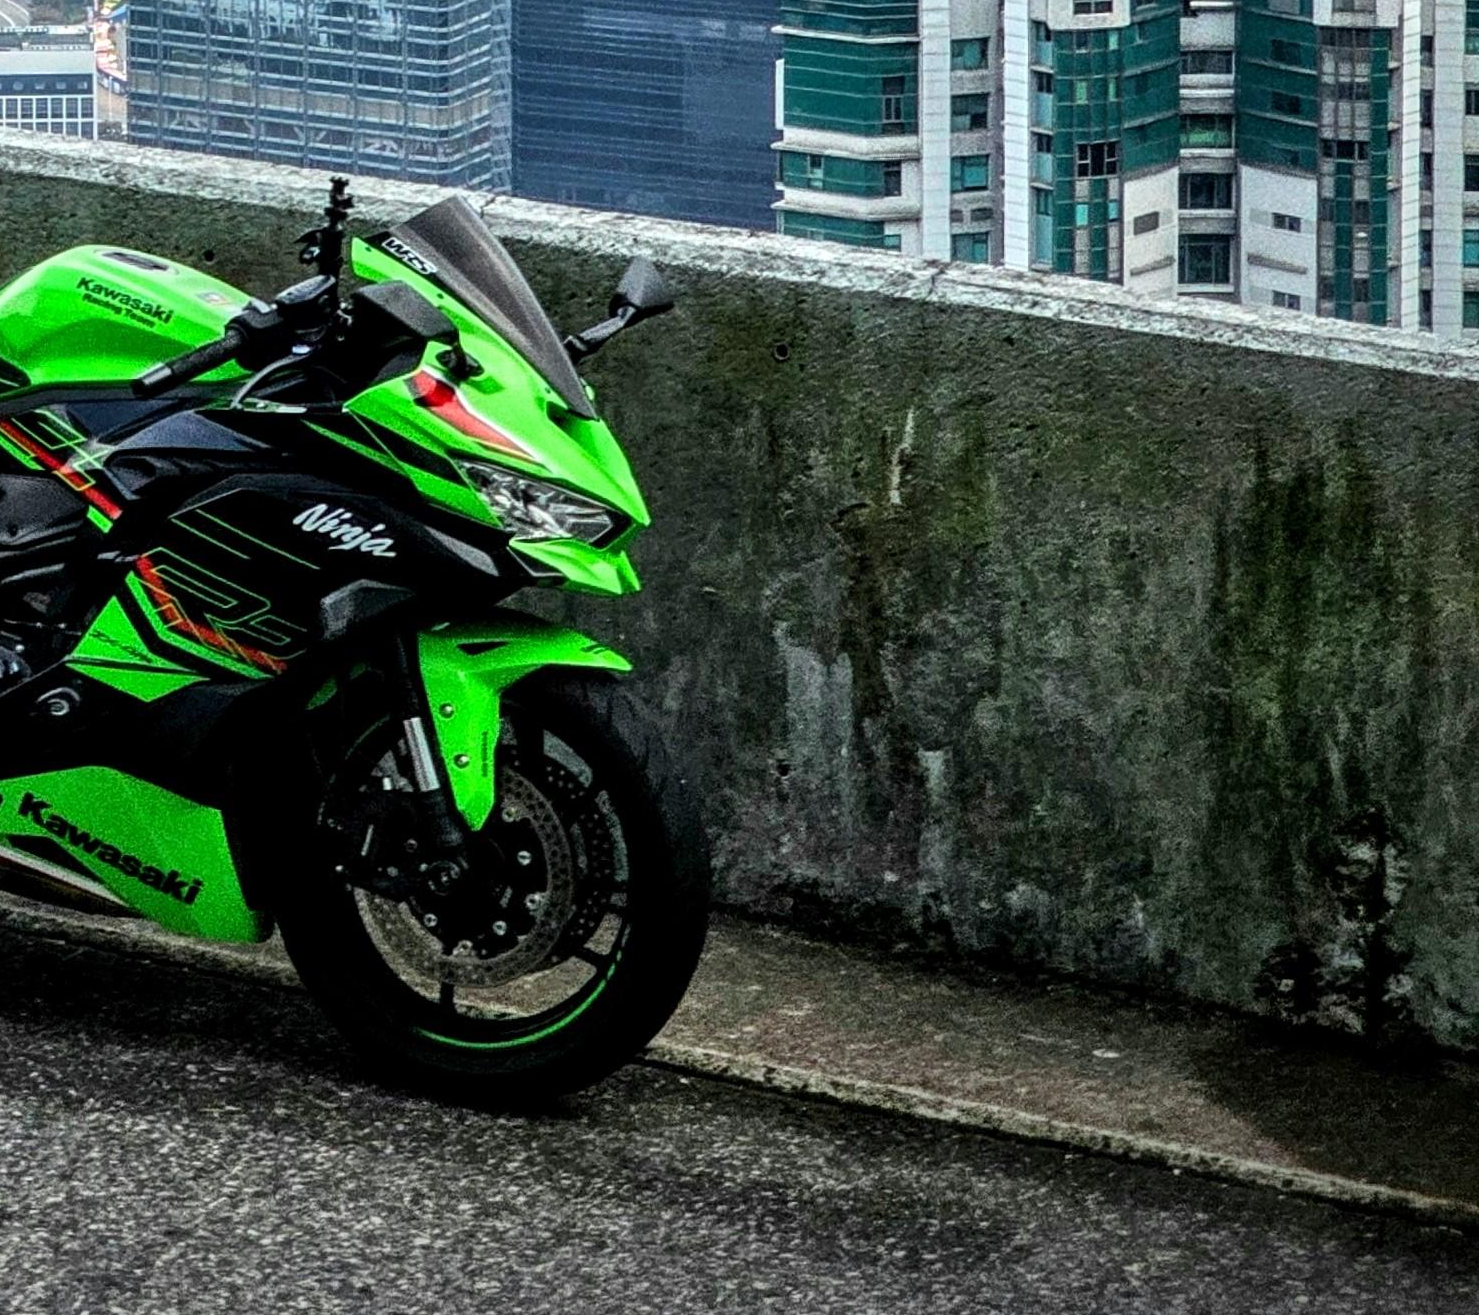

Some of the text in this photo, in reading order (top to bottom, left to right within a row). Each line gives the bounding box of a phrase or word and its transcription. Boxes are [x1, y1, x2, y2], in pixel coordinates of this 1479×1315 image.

[76, 277, 174, 324] Kawasaki
[82, 292, 156, 328] Racing Team
[292, 503, 397, 557] Ninja
[17, 791, 204, 905] Kawasaki
